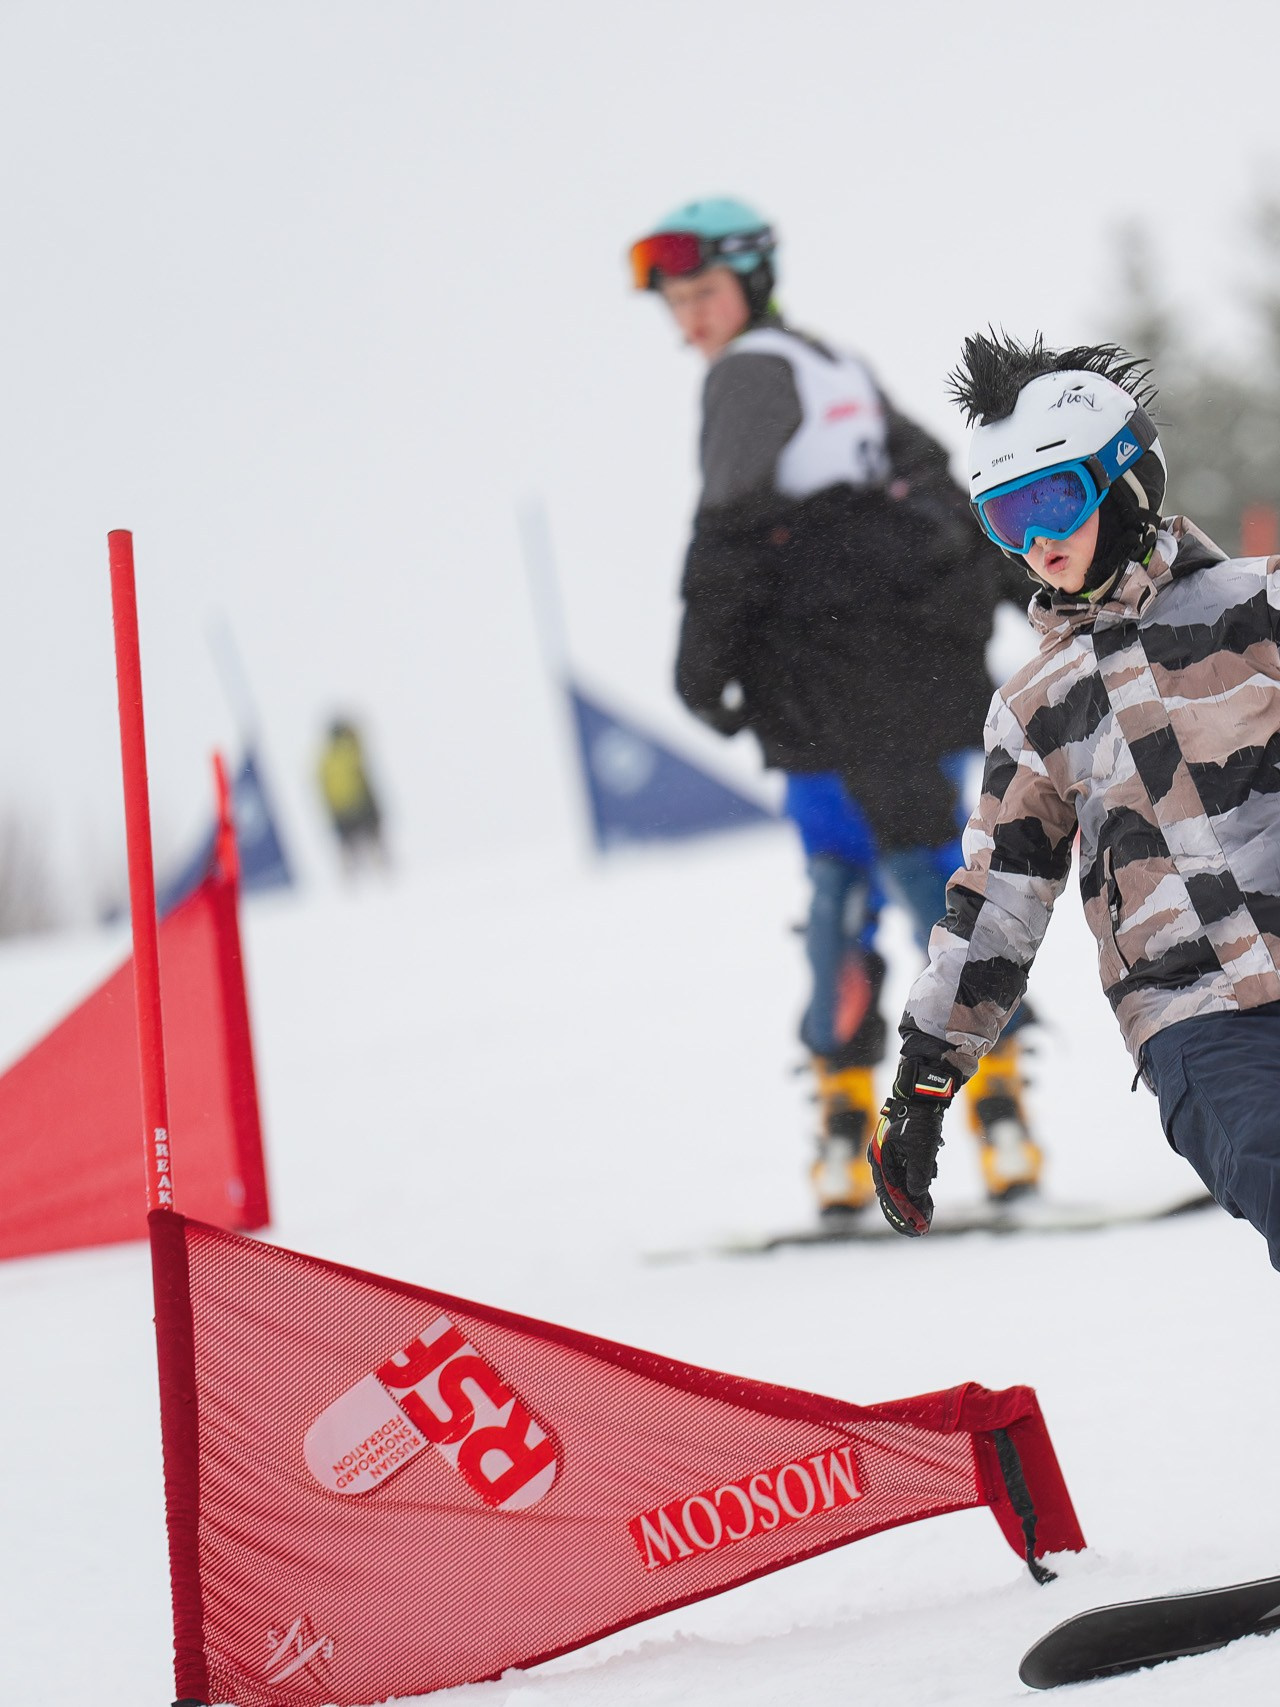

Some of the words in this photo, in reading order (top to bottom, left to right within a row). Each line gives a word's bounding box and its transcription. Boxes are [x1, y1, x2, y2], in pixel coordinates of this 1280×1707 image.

[991, 452, 1014, 467] SMITH
[154, 1127, 173, 1210] BREAK
[332, 1414, 404, 1474] FEDERATION
[376, 1324, 557, 1508] RSF
[336, 1425, 412, 1488] SNOWBOARD
[369, 1435, 420, 1479] RUSSIAN
[640, 1446, 862, 1568] MOSCOW
